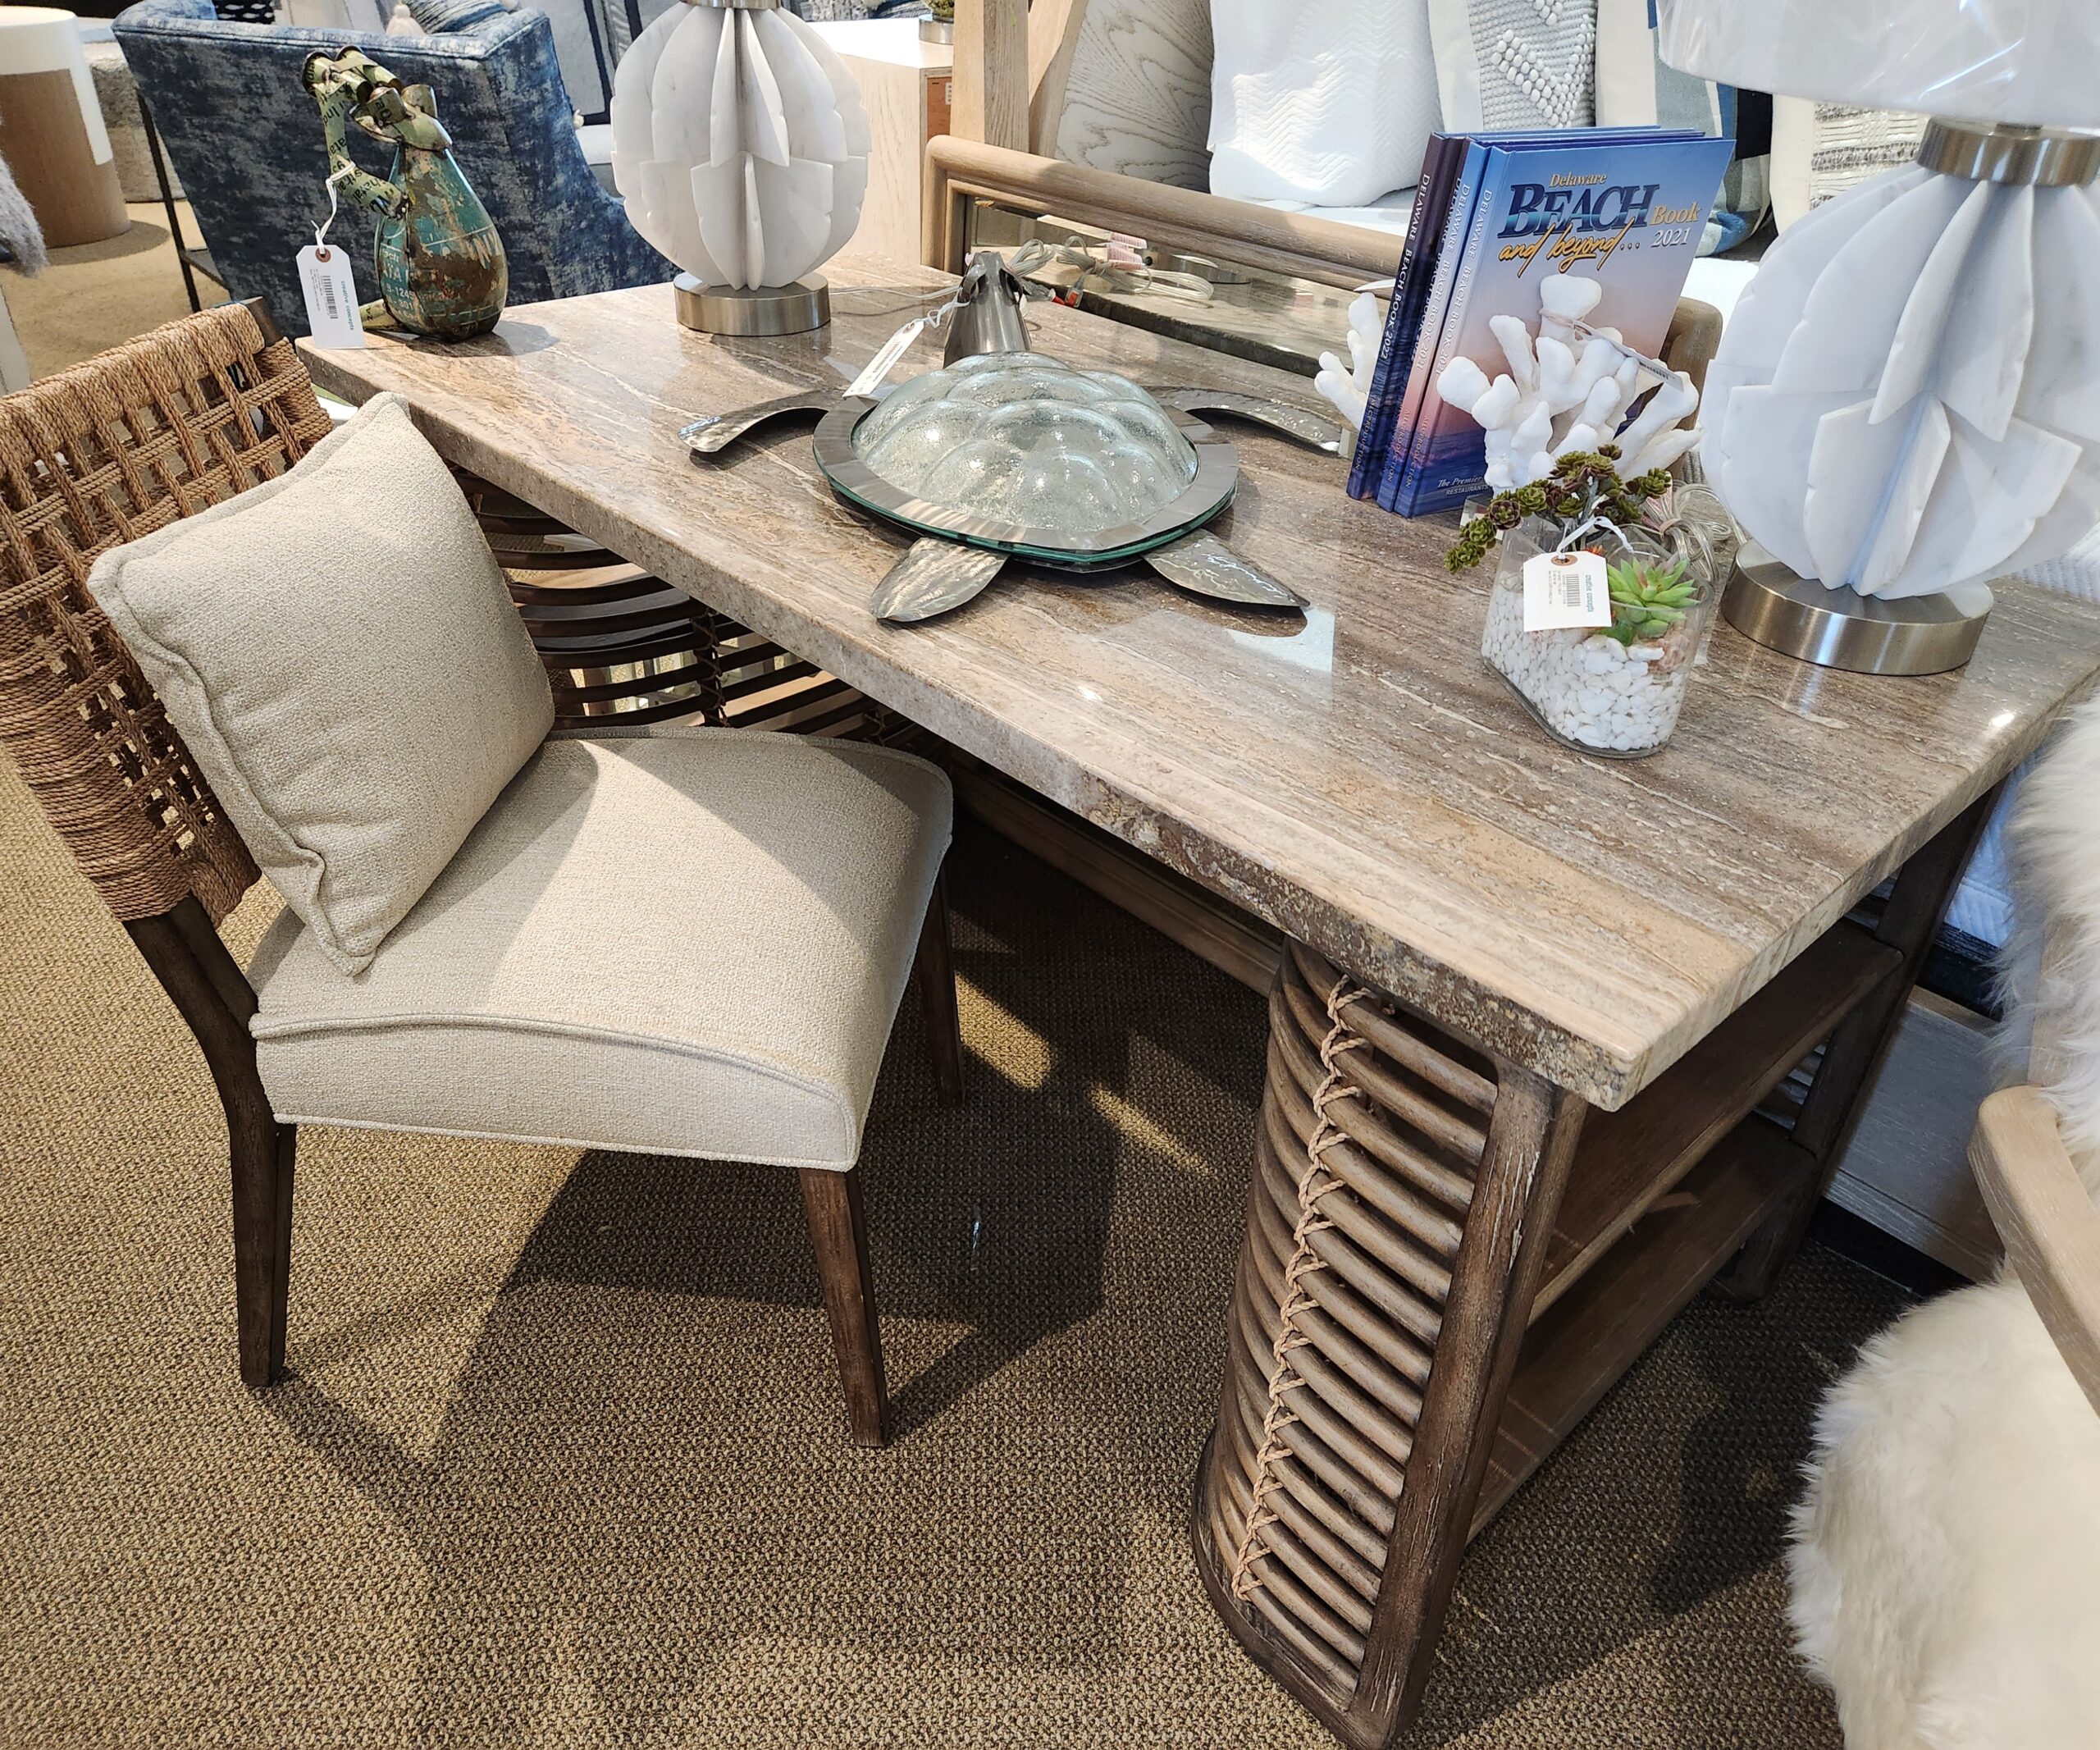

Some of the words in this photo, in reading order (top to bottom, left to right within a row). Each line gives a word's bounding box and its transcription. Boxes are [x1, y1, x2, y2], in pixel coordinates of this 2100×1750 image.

[1549, 171, 1607, 188] Delaware
[1408, 173, 1431, 241] DELAWARE
[1448, 184, 1470, 253] DELAWARE
[1468, 190, 1492, 259] DELAWARE
[1497, 184, 1659, 239] BEACH
[1649, 201, 1702, 226] Book
[1499, 222, 1556, 278] and
[1650, 227, 1693, 248] 2021
[1397, 251, 1413, 290] BEACH
[1434, 260, 1450, 303] BEACH
[1454, 266, 1472, 308] BEACH
[346, 305, 354, 331] concepts
[1386, 292, 1403, 330] BOOK
[1424, 305, 1439, 341] BOOK
[1444, 311, 1459, 348] BOOK
[1381, 331, 1394, 359] 2022
[1417, 343, 1429, 370] 2021
[1437, 478, 1451, 488] The
[1451, 476, 1484, 486] Premier
[1445, 484, 1489, 496] RESTAURANTS
